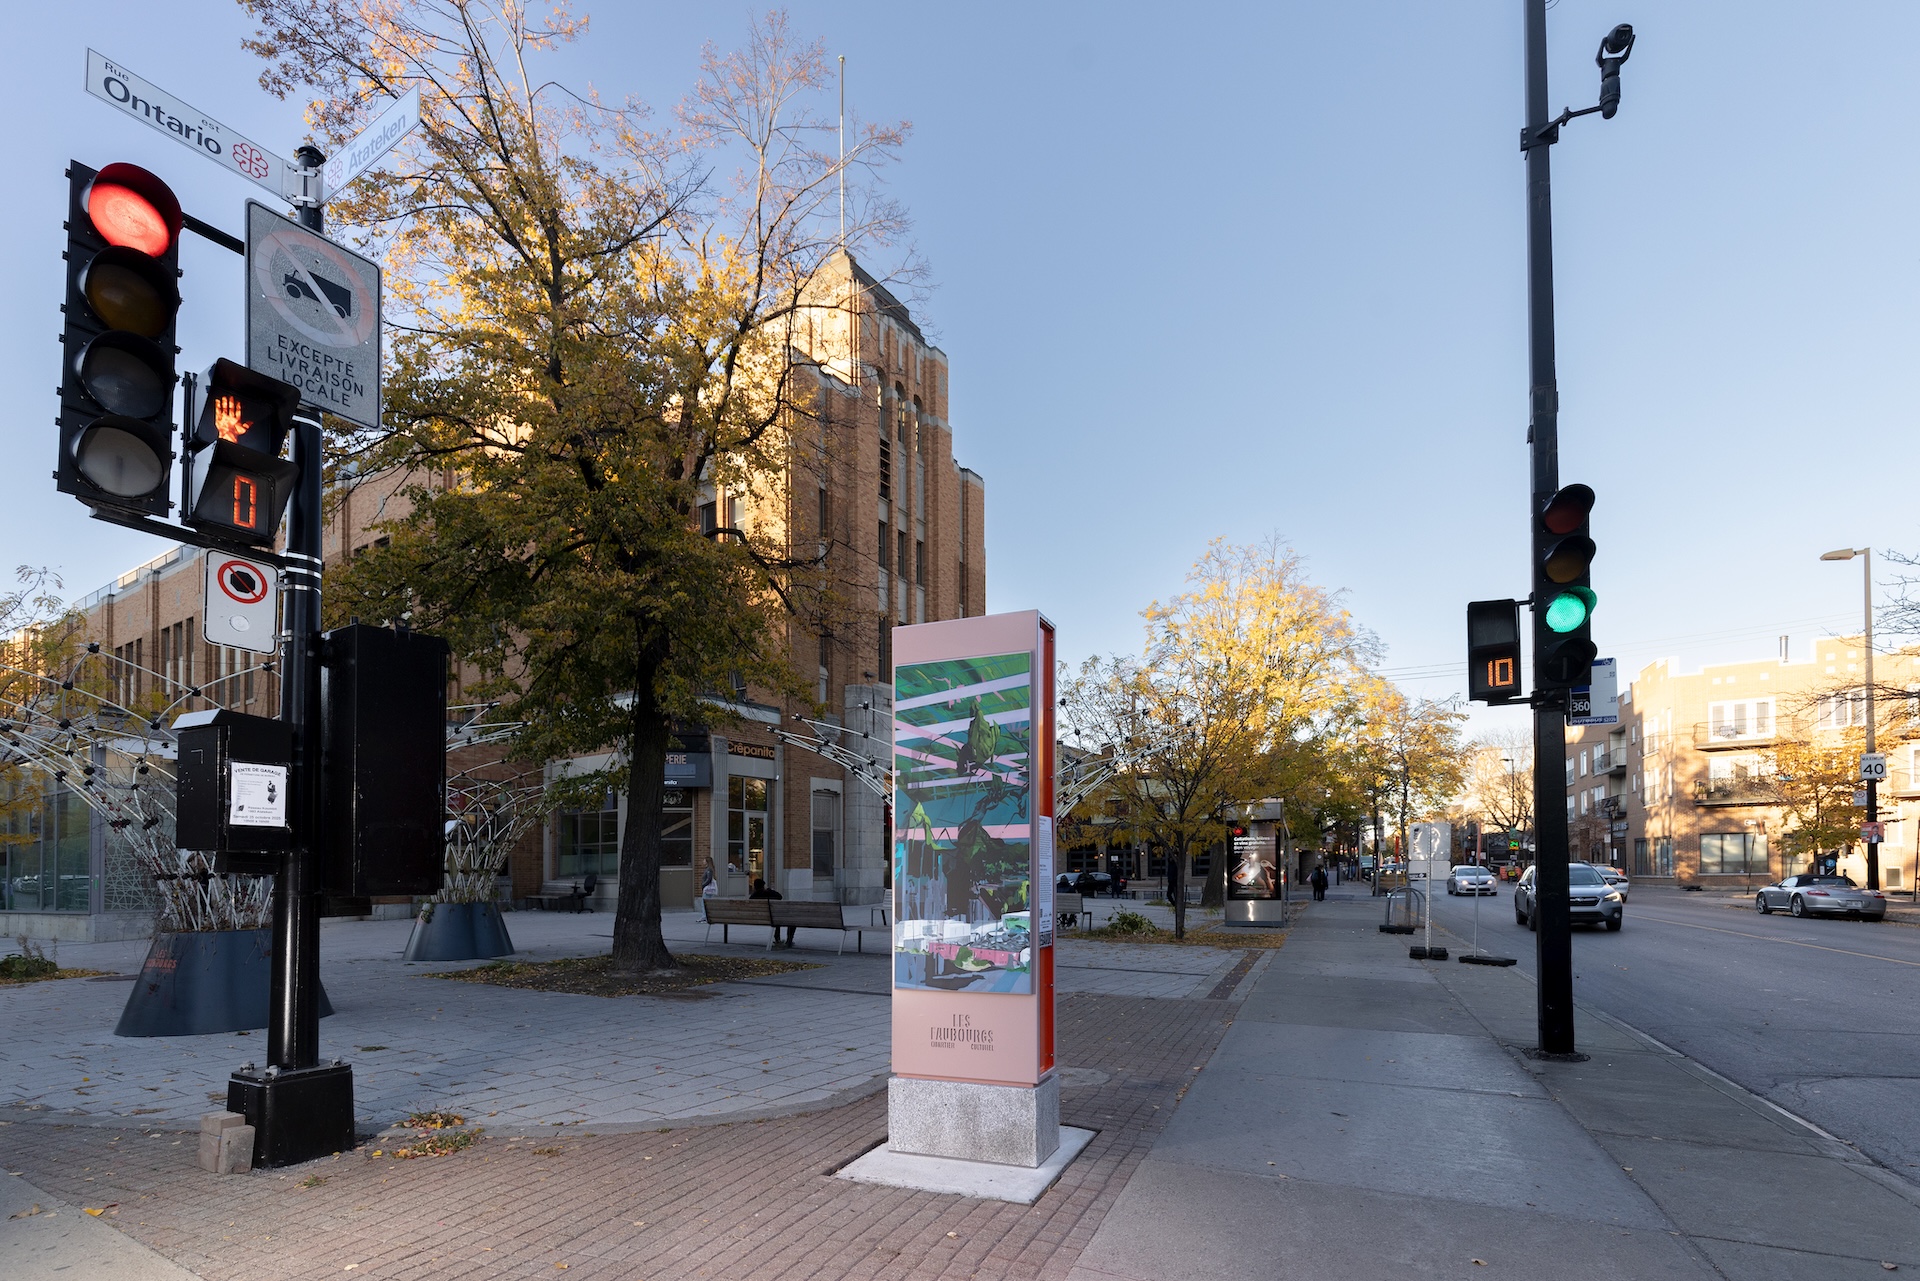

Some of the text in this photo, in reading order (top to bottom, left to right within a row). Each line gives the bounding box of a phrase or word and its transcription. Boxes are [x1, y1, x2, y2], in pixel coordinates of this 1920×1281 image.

[104, 61, 129, 81] Rue
[103, 76, 222, 156] Ontario est
[348, 114, 406, 175] Atateken
[278, 334, 355, 378] EXCEPTÉ
[267, 346, 364, 398] LIVRAISON
[282, 368, 351, 408] LOCALE
[1487, 657, 1514, 688] 10
[1572, 701, 1590, 712] 360
[727, 741, 775, 758] Crêpanita
[260, 768, 281, 777] GARAGE
[1863, 763, 1884, 775] 40
[953, 1014, 970, 1028] LES
[930, 1027, 994, 1043] FAUBOURGS
